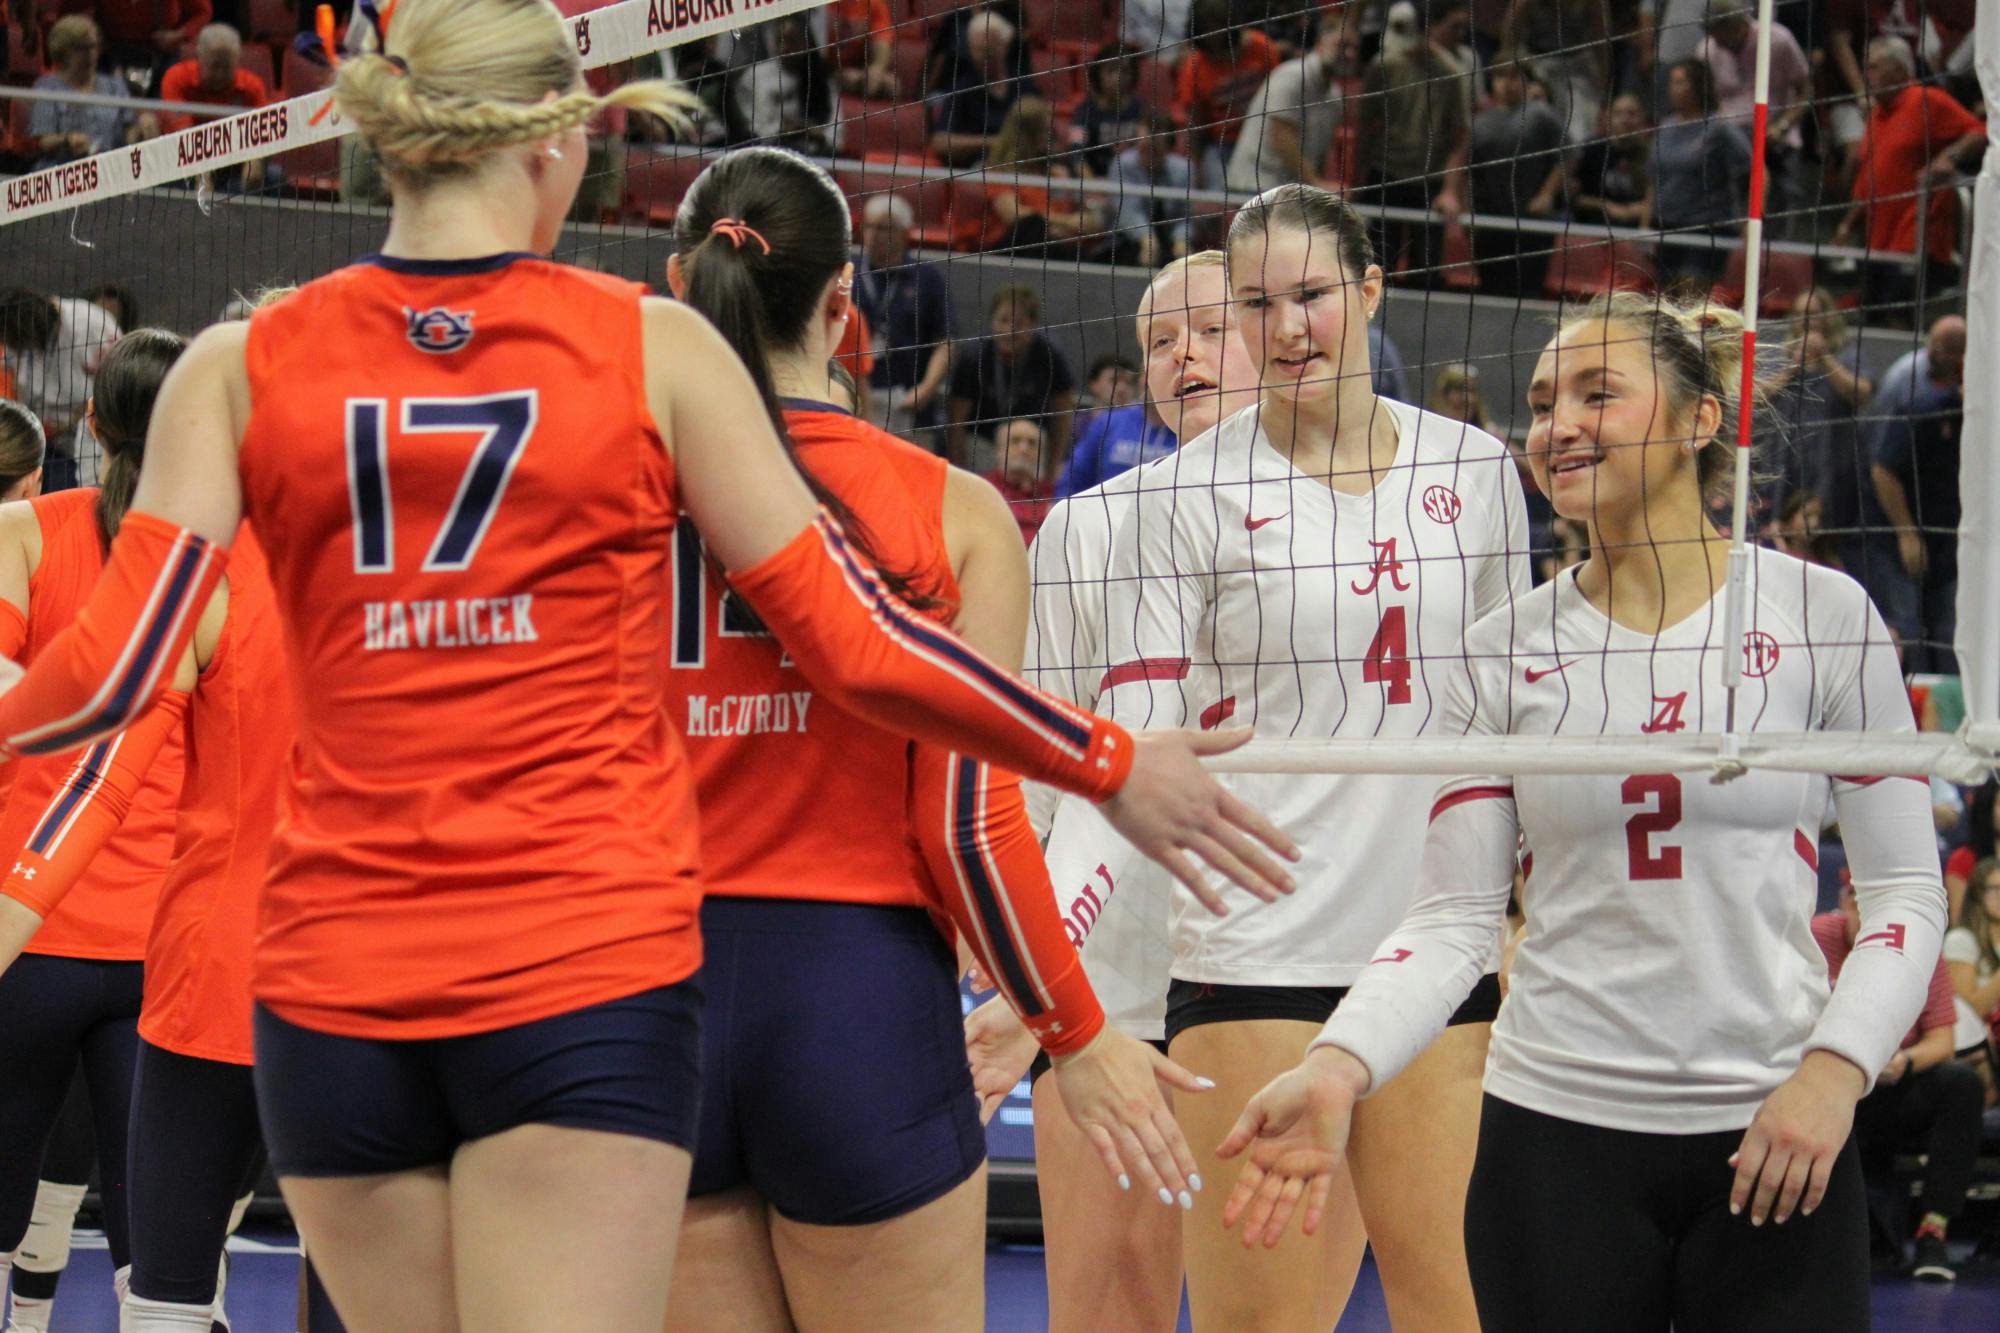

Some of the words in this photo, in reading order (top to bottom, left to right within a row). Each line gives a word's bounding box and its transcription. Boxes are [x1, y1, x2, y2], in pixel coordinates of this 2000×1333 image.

[178, 124, 233, 167] AUBURN
[236, 106, 288, 149] TIGERS
[6, 174, 53, 212] AUBURN
[55, 160, 99, 198] TIGERS
[344, 388, 539, 574] 17
[1423, 485, 1461, 524] SEC
[1351, 537, 1411, 595] A
[363, 593, 539, 650] HAVLICEK
[1363, 606, 1412, 704] 4
[1740, 632, 1780, 678] EC
[687, 692, 813, 736] McCURDY
[1621, 773, 1682, 880] 2
